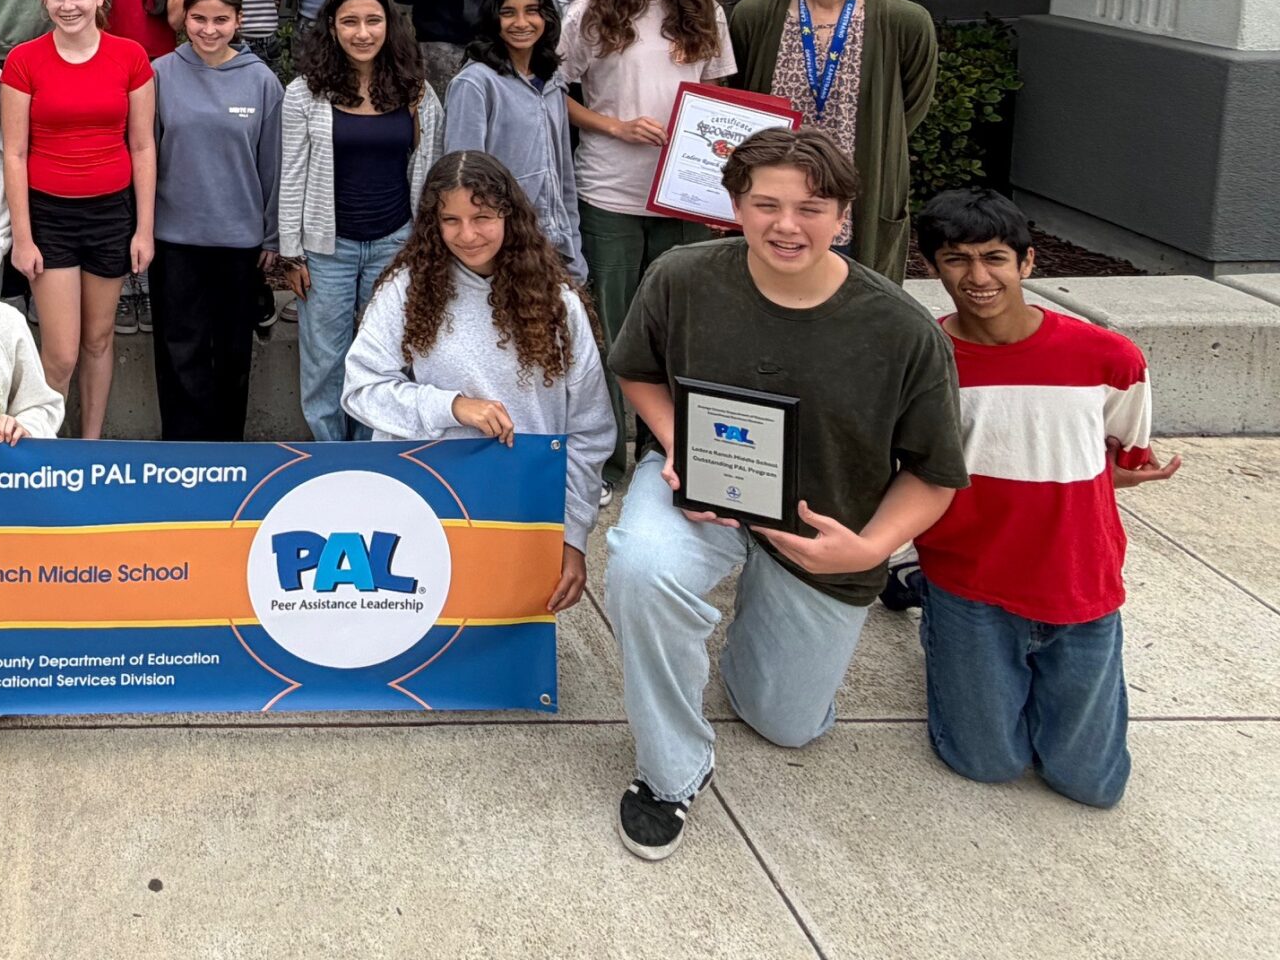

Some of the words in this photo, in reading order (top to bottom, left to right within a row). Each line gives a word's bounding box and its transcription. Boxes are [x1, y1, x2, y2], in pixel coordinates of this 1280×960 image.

[838, 3, 853, 38] CAPISTRANO
[713, 422, 755, 444] PAL
[91, 463, 136, 485] PAL
[143, 463, 247, 489] Program
[38, 565, 112, 583] Middle
[118, 562, 189, 583] School
[271, 530, 418, 594] PAL
[271, 599, 297, 611] Peer
[299, 599, 357, 610] Assistance
[361, 598, 424, 613] Leadership
[39, 654, 125, 670] Department
[129, 654, 144, 666] of
[147, 652, 220, 666] Education
[56, 674, 117, 687] Services
[120, 672, 175, 686] Division
